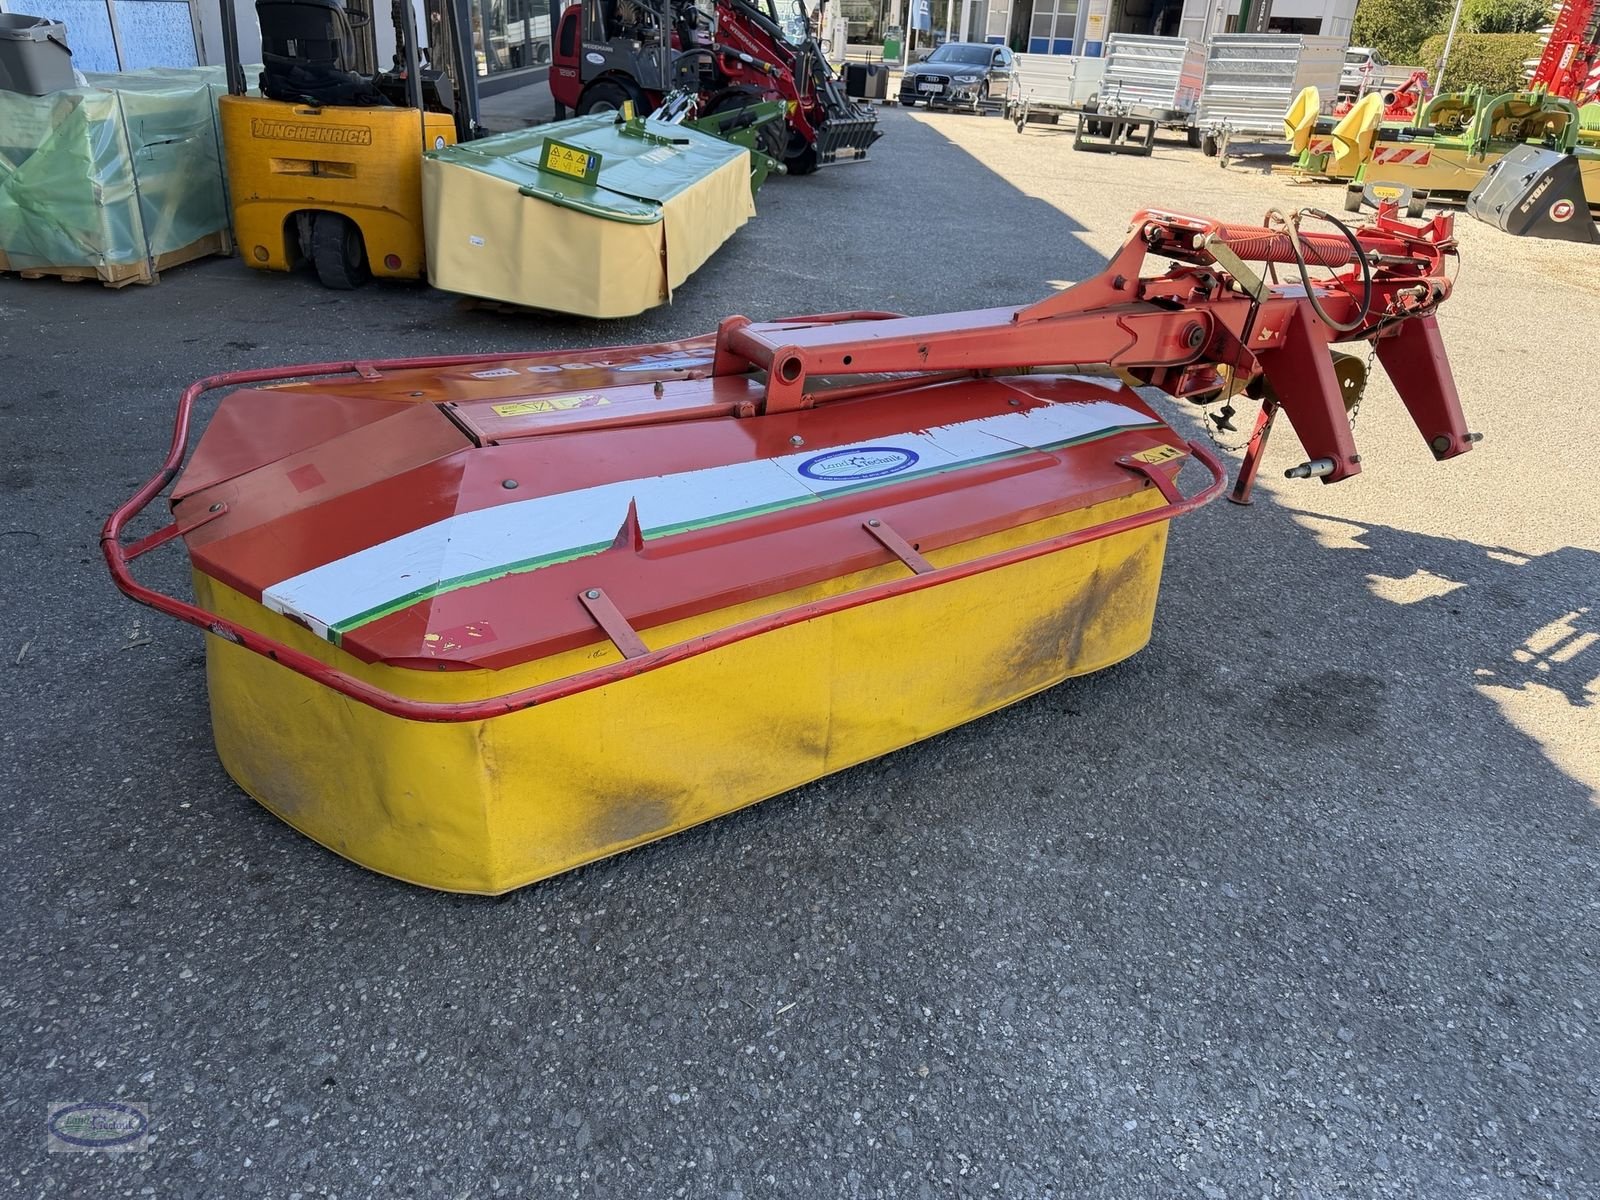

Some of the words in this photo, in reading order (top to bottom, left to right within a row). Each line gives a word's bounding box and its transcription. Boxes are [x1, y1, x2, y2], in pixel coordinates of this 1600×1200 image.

[729, 23, 760, 54] WEIDEMANN
[254, 119, 370, 143] JUNGHEINRICH
[1520, 176, 1554, 213] STOLL
